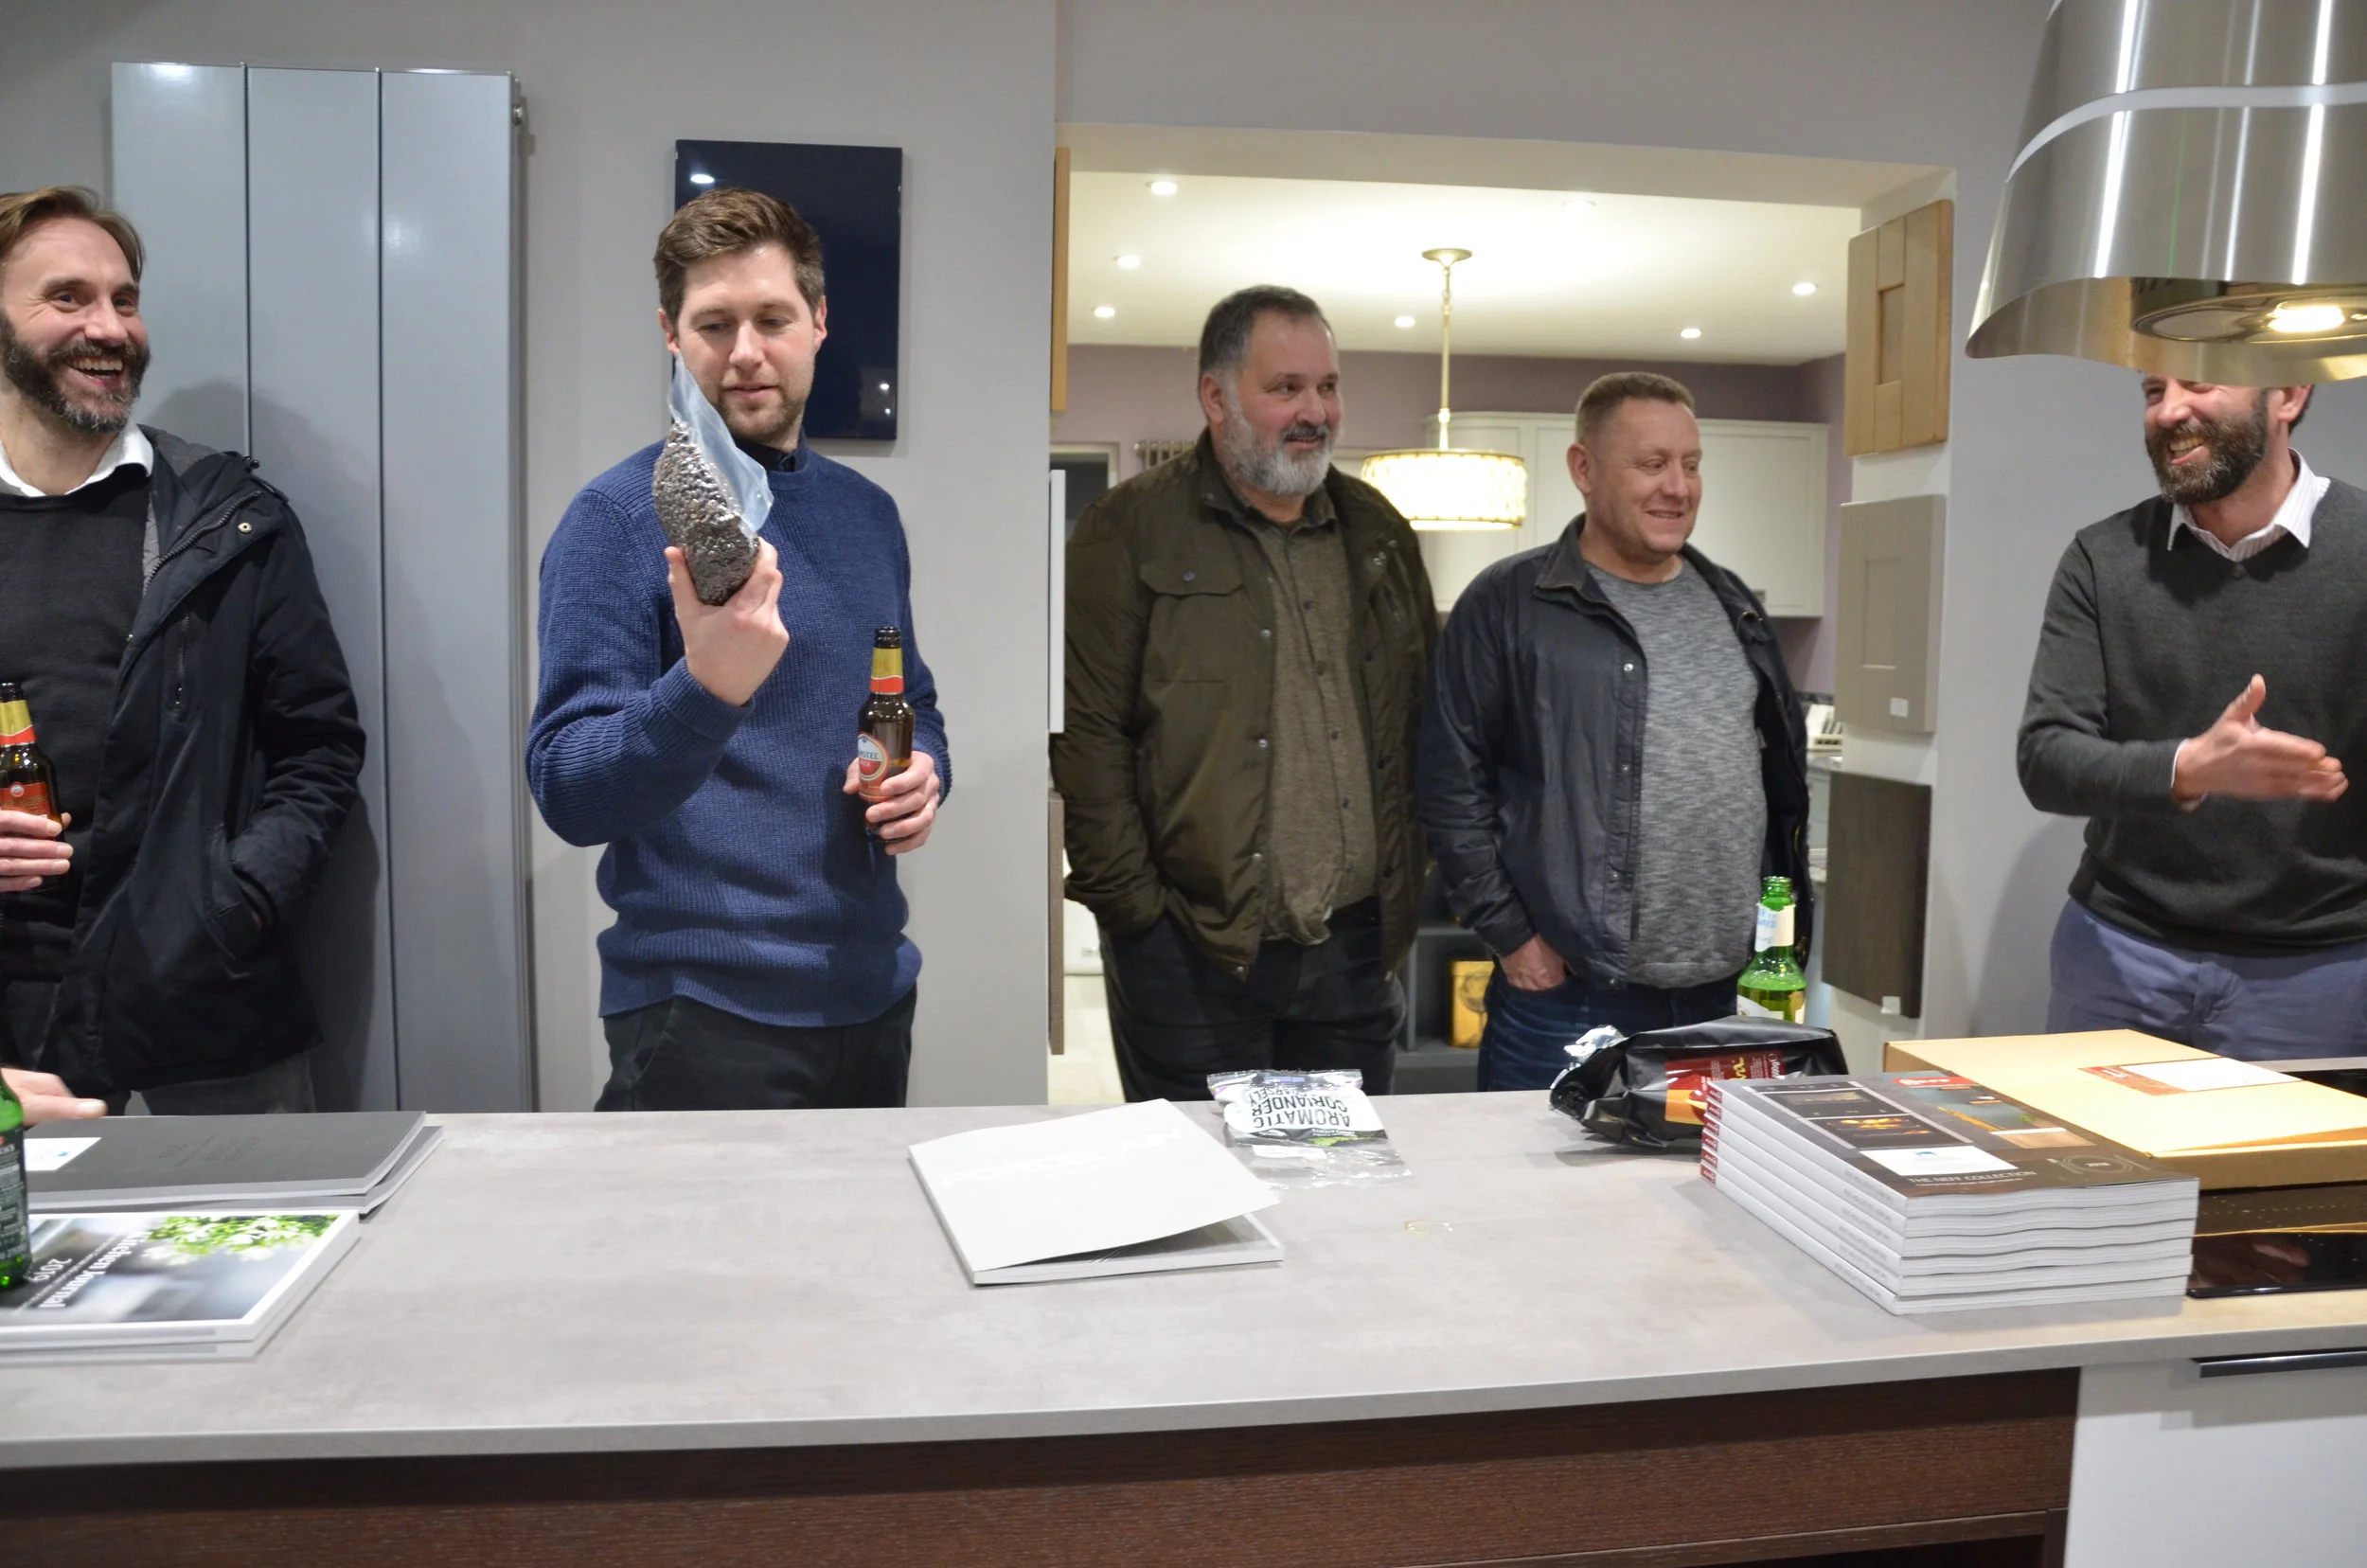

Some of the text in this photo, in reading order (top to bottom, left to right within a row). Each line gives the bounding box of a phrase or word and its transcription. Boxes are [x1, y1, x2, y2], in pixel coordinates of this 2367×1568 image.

[1252, 1096, 1348, 1116] CORIANDER
[1253, 1109, 1350, 1128] AROMATIC
[1965, 1170, 2038, 1181] COLLECTION
[27, 1257, 73, 1282] 2019
[37, 1270, 106, 1309] Journal
